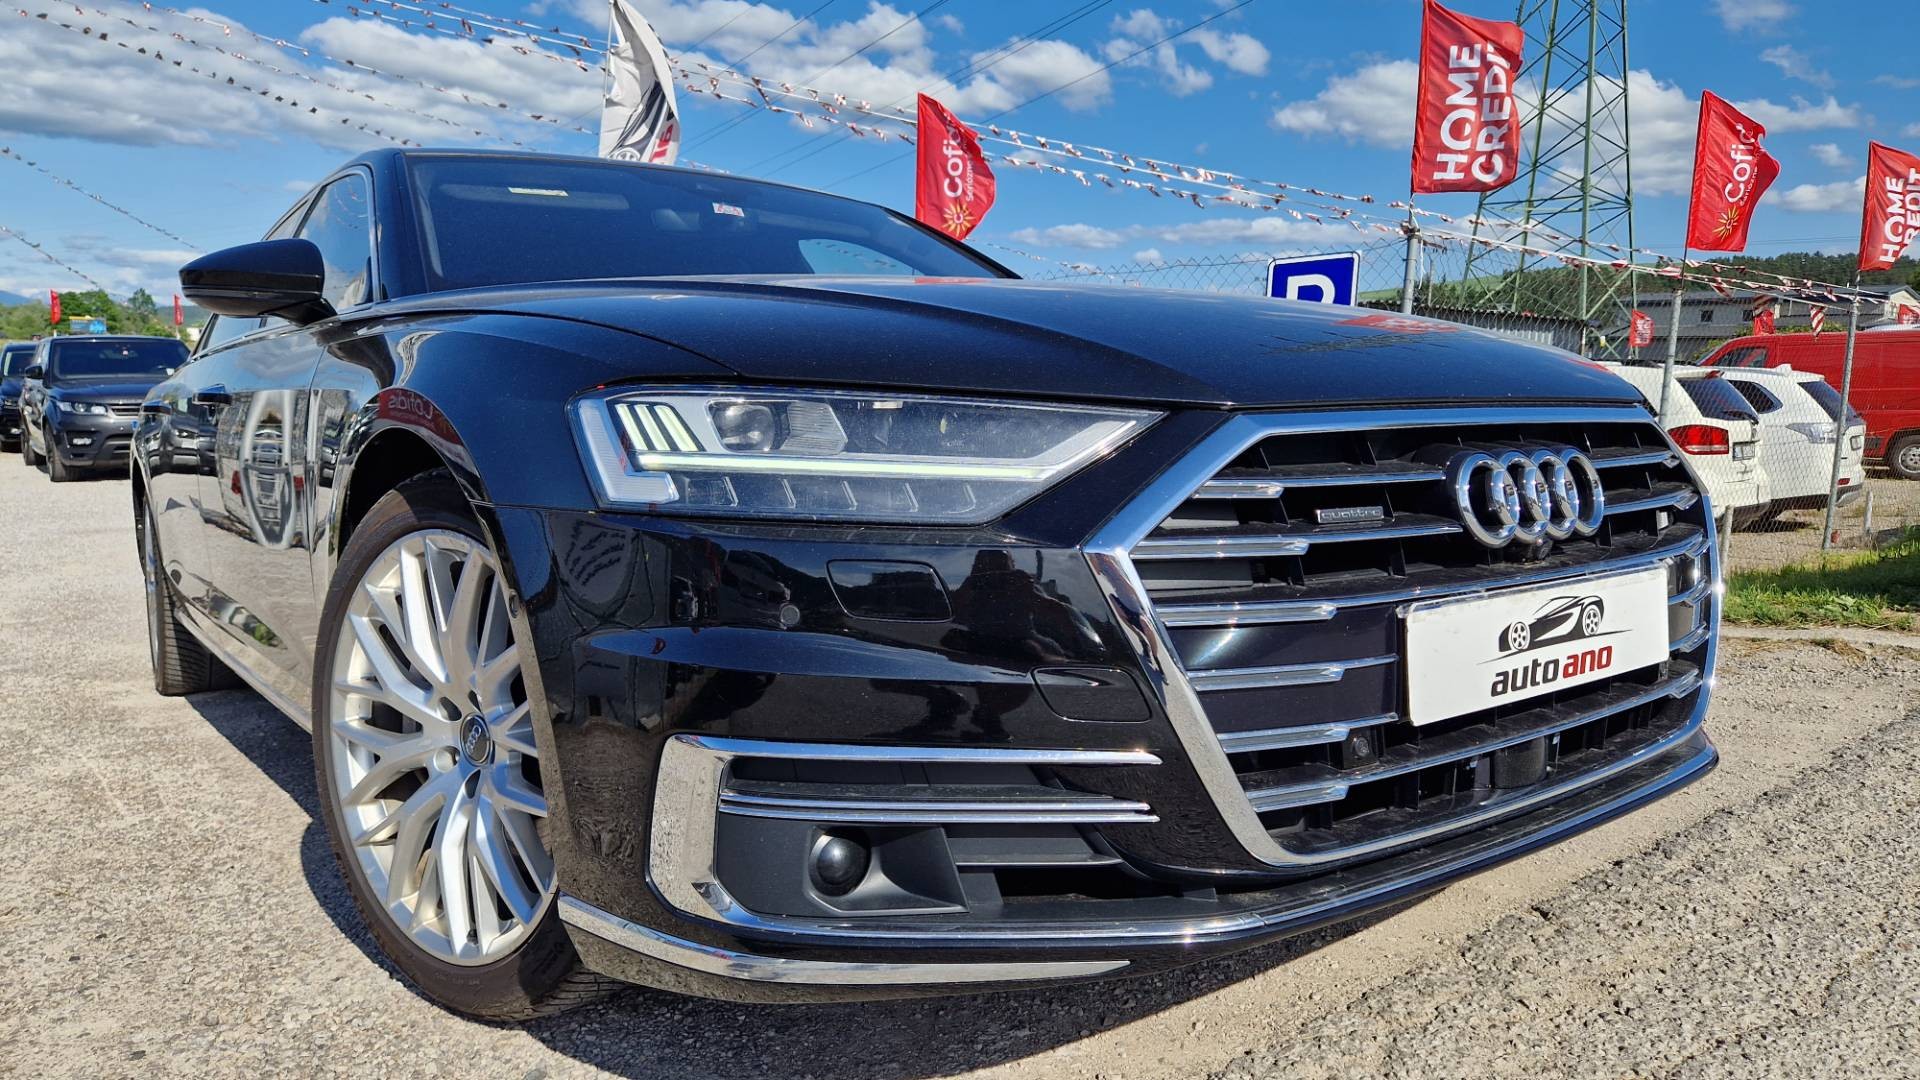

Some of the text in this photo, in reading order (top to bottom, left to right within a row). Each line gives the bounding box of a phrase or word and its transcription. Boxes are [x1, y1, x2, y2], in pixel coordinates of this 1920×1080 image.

[1433, 43, 1482, 180] HOME
[1879, 176, 1906, 262] HOME
[1321, 509, 1381, 520] quattro
[1490, 645, 1613, 697] auto ano
